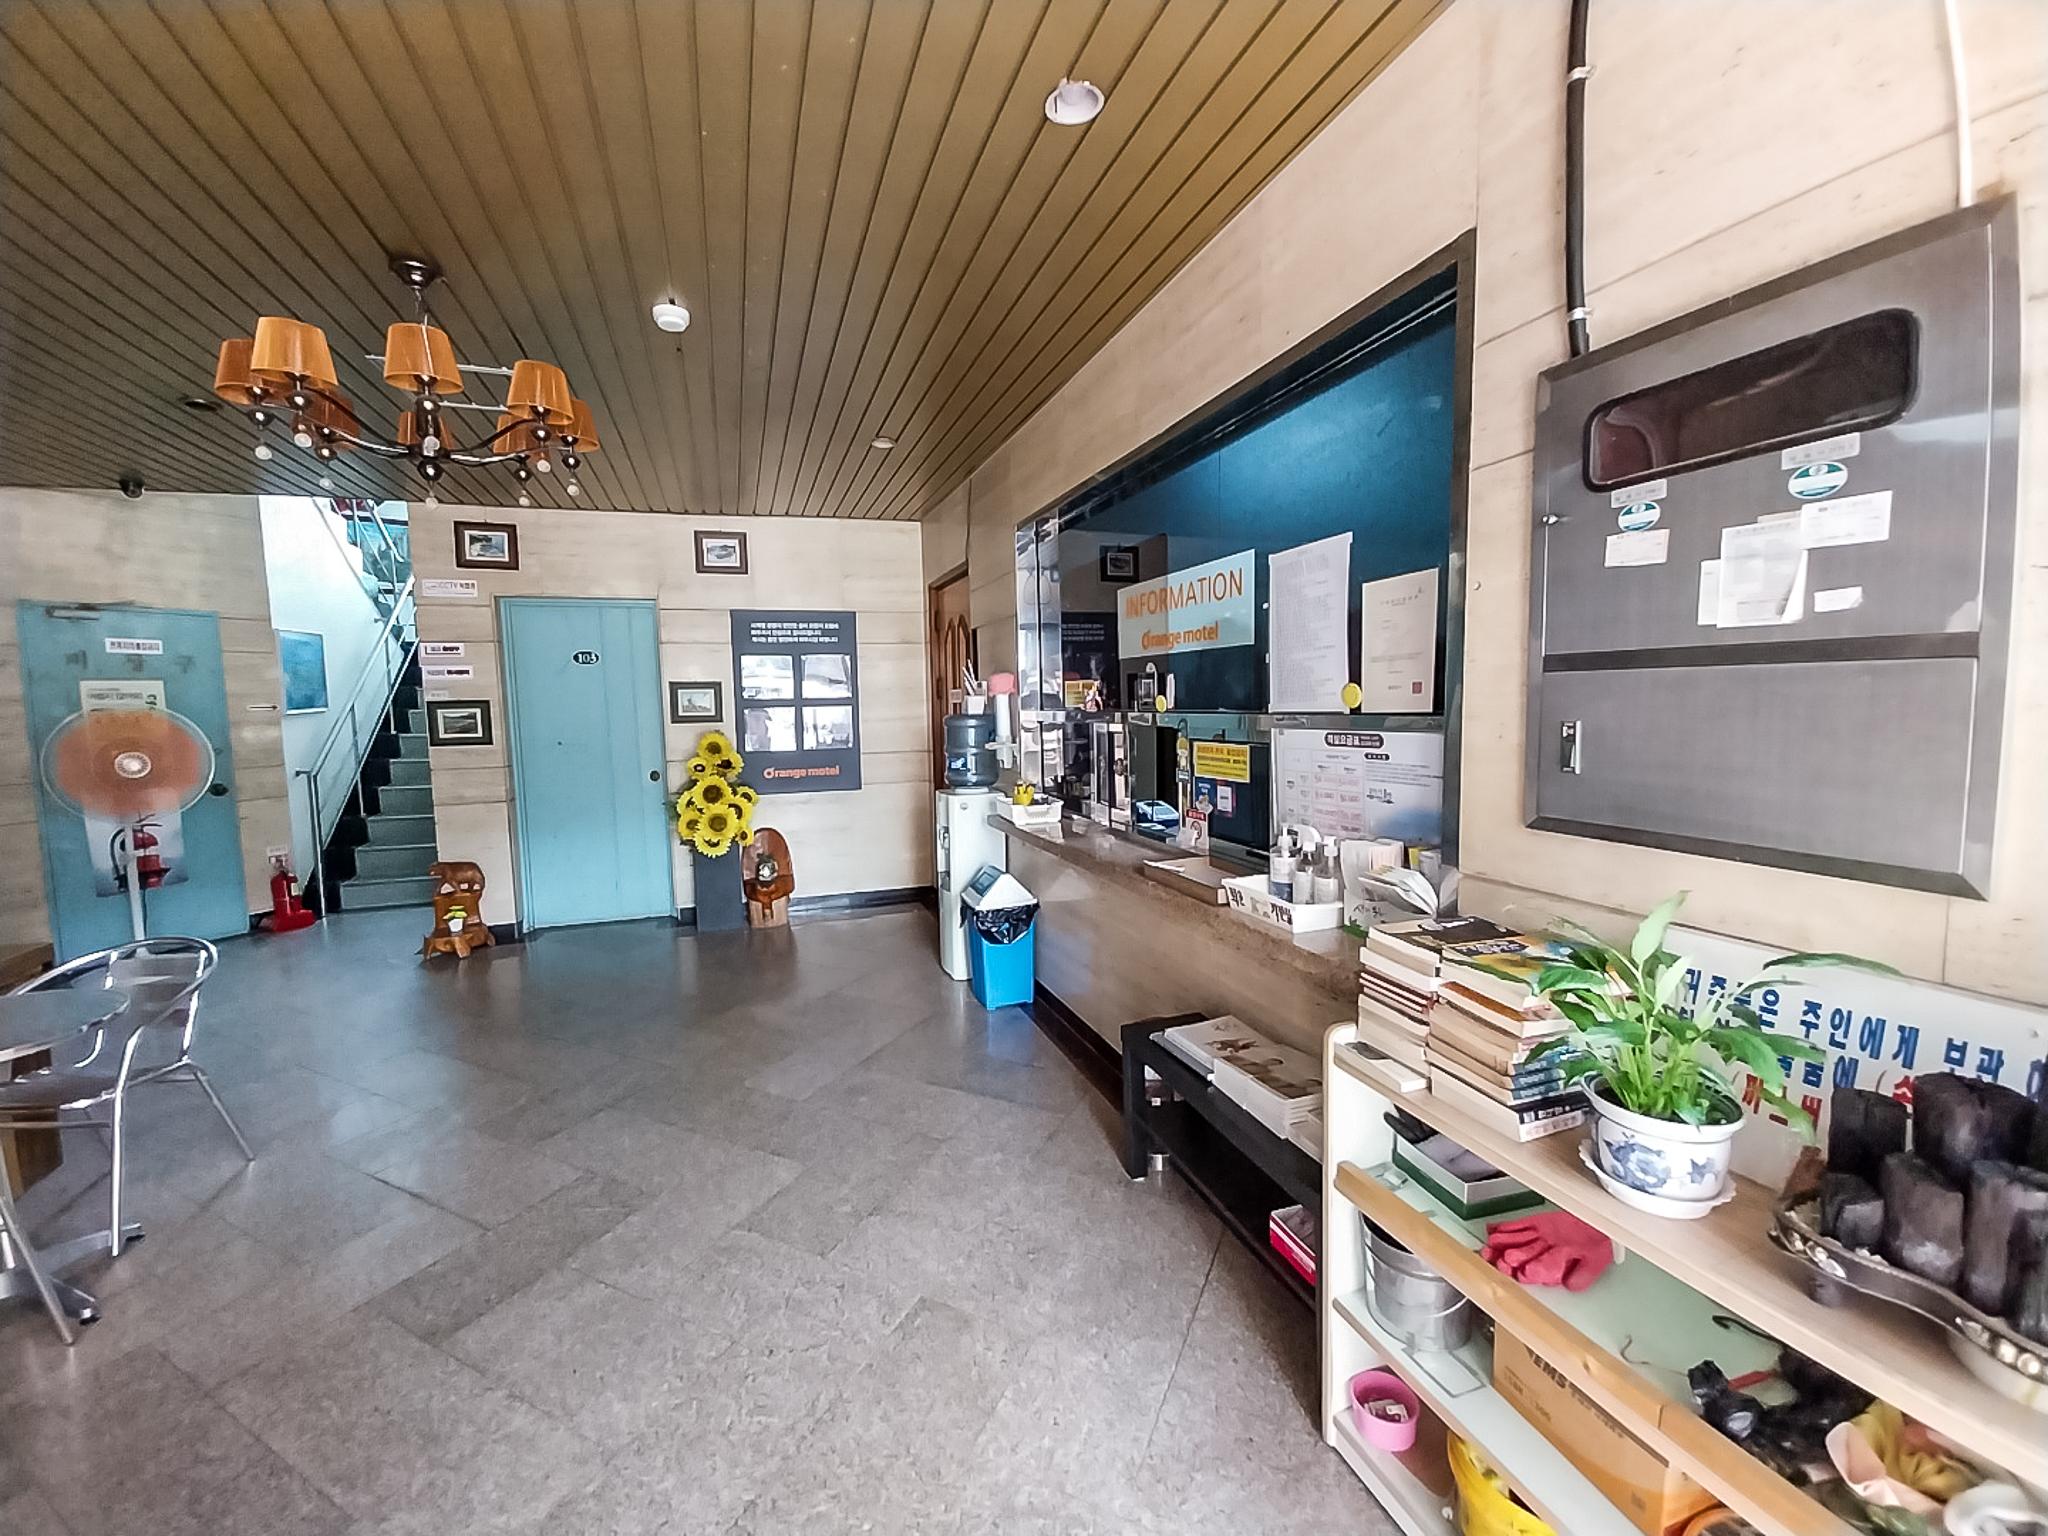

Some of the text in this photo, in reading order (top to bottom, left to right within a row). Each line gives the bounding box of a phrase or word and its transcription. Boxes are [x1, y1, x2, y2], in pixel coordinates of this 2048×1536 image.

[1125, 567, 1244, 619] INFORMATION
[1141, 620, 1219, 651] Orange motel
[807, 765, 840, 777] motel
[1799, 999, 1921, 1070] 주인에게
